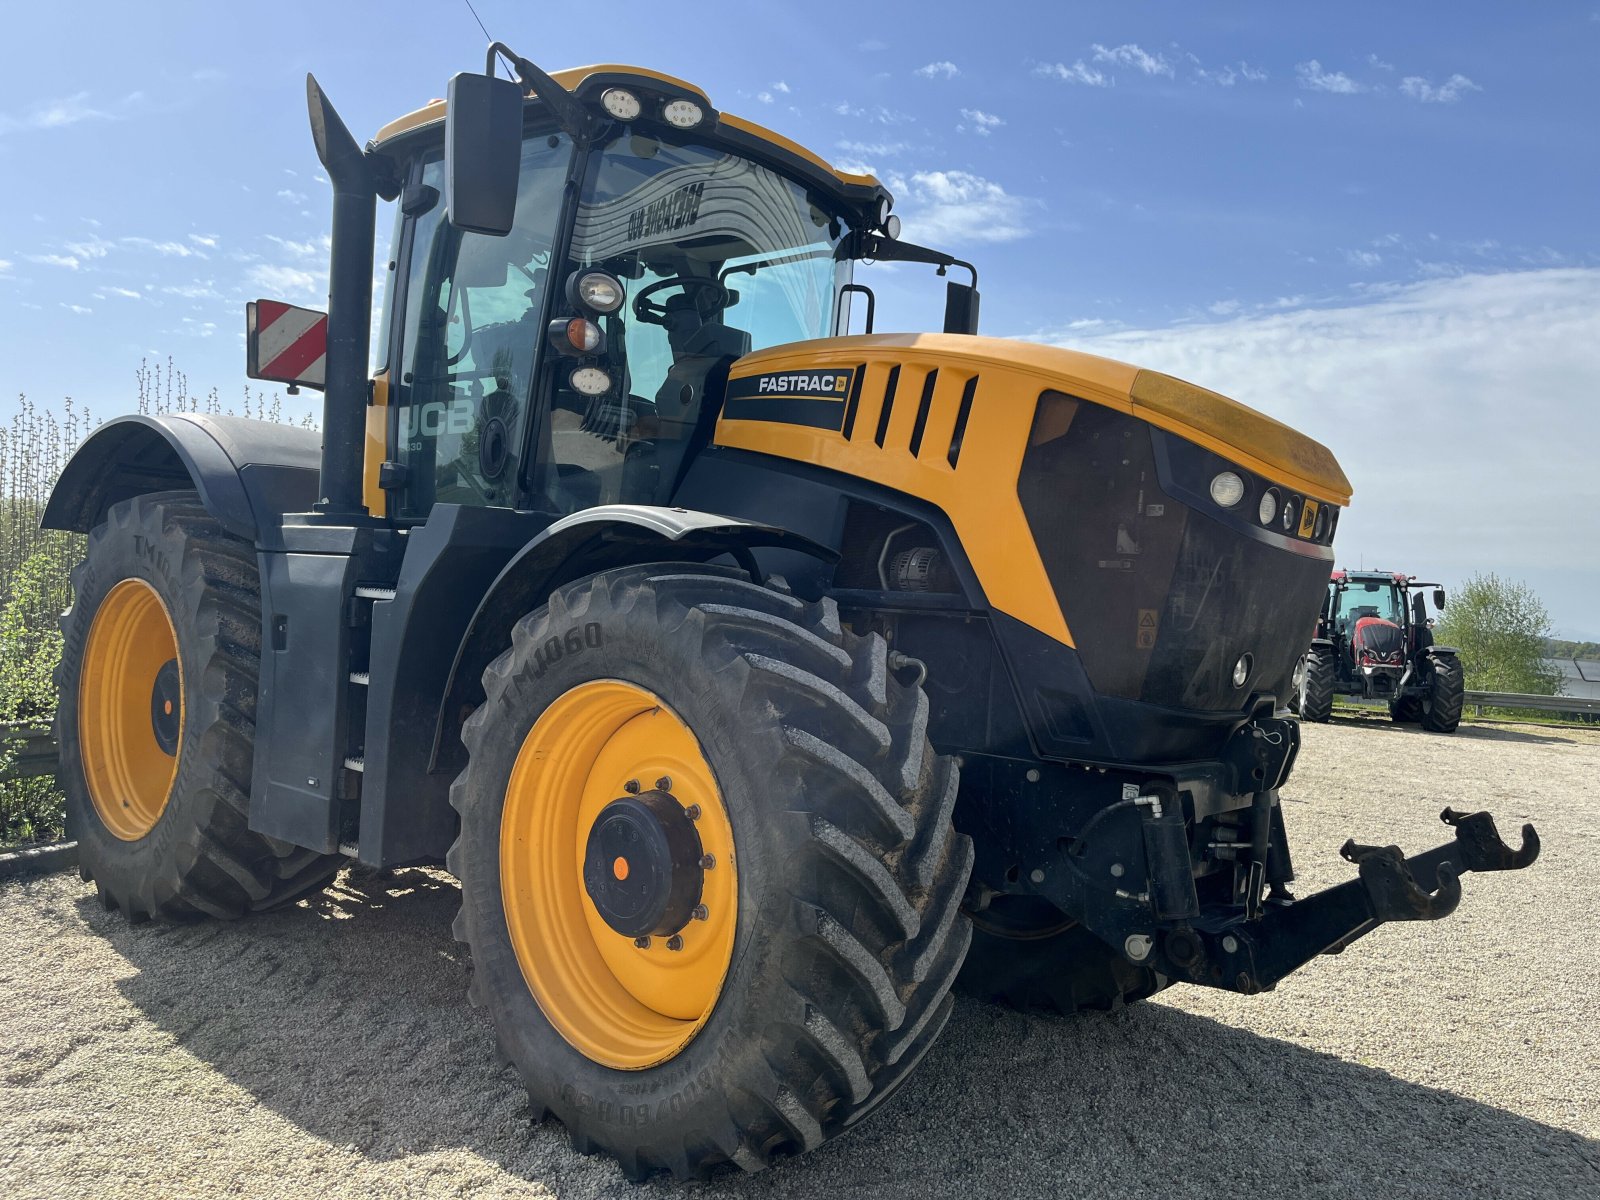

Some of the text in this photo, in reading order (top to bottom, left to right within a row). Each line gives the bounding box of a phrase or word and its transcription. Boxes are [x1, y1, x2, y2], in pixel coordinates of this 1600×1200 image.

[758, 375, 834, 393] FASTRAC
[399, 399, 475, 439] JCB
[497, 621, 604, 711] TM1060
